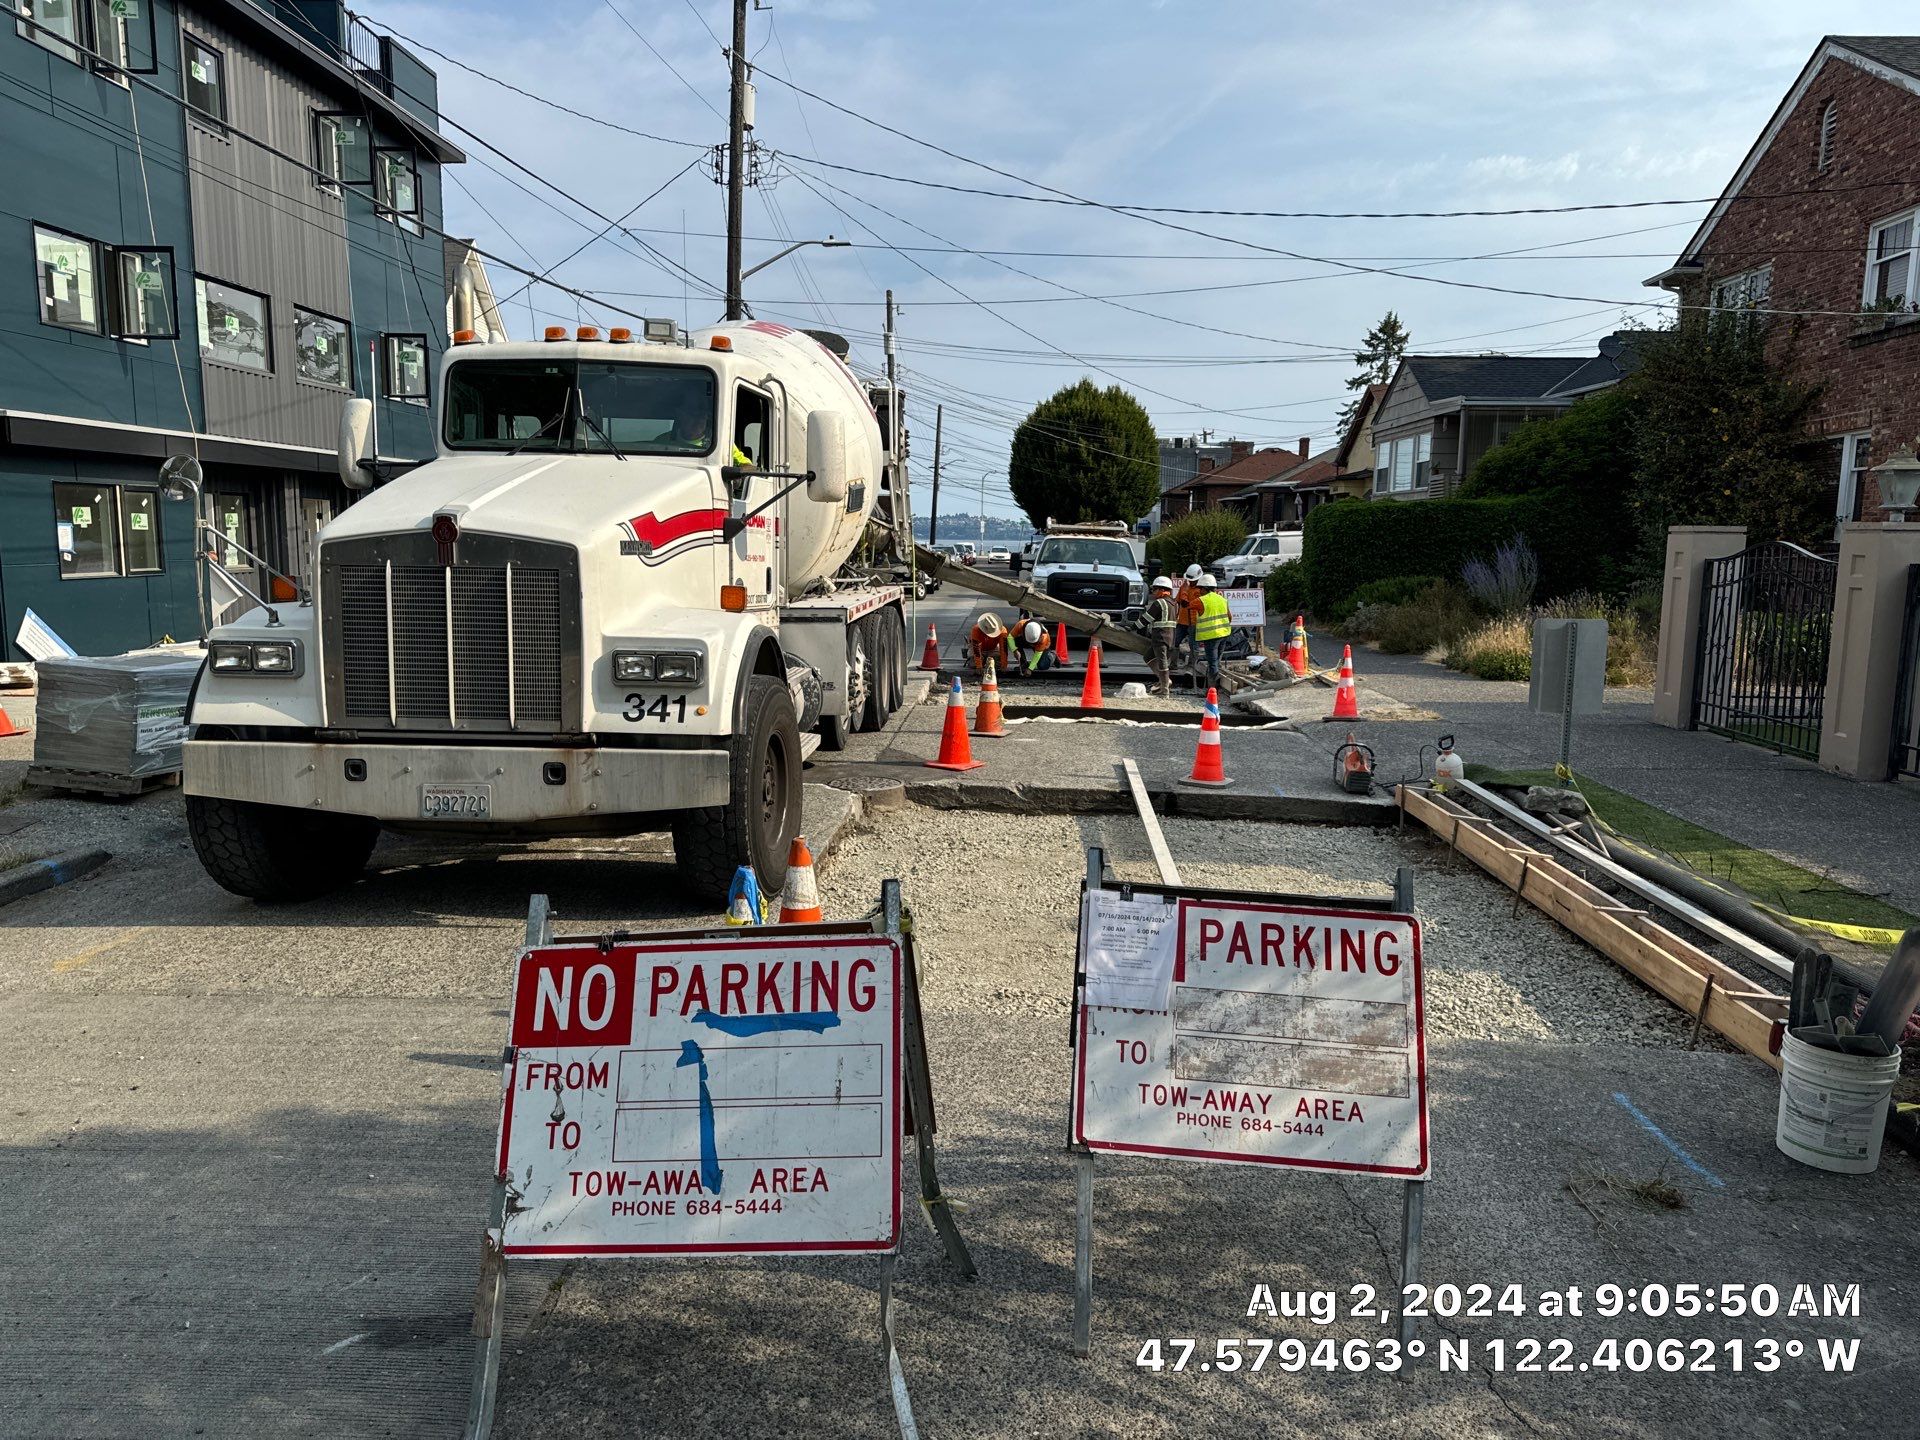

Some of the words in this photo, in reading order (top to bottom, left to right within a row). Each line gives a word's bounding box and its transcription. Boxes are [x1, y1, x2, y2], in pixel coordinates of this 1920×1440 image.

[1226, 591, 1259, 599] PARKING
[622, 693, 686, 723] 341
[425, 795, 487, 812] C39272C
[1098, 912, 1131, 921] 07/16/2024
[1200, 918, 1400, 977] PARKING
[533, 963, 616, 1032] NO
[650, 958, 877, 1016] PARKING
[1115, 1039, 1147, 1065] TO
[525, 1061, 609, 1090] FROM
[1138, 1083, 1273, 1115] TOW-AWAY
[1295, 1097, 1365, 1123] AREA
[545, 1120, 581, 1150] TO
[1176, 1112, 1232, 1129] PHONE
[1240, 1117, 1324, 1136] 684-5444
[569, 1168, 723, 1197] TOW-AWA
[750, 1167, 829, 1194] AREA
[612, 1200, 676, 1216] PHONE
[686, 1199, 783, 1215] 684-5444
